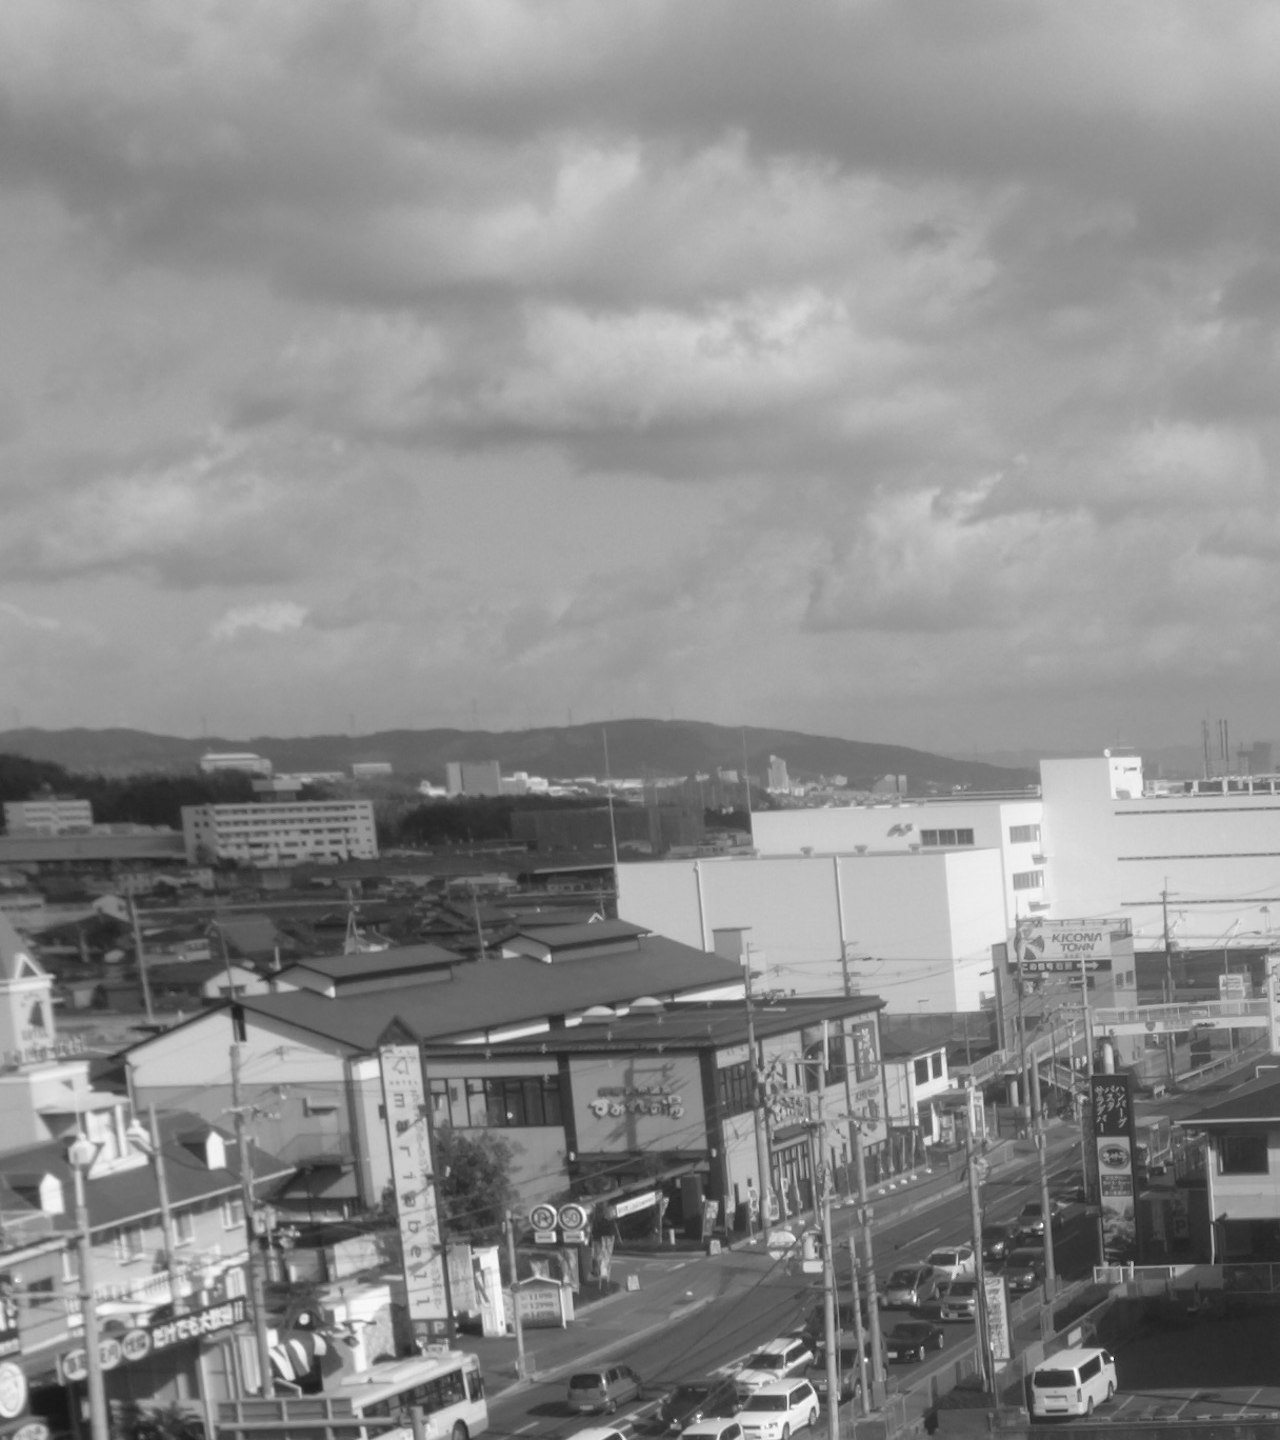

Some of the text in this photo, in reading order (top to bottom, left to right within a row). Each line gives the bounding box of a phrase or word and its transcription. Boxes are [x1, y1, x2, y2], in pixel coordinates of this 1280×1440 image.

[1052, 932, 1102, 943] KICONA
[1061, 942, 1095, 952] TOWN
[1104, 1085, 1116, 1112] パスタ
[1115, 1085, 1127, 1129] ハンバーグ
